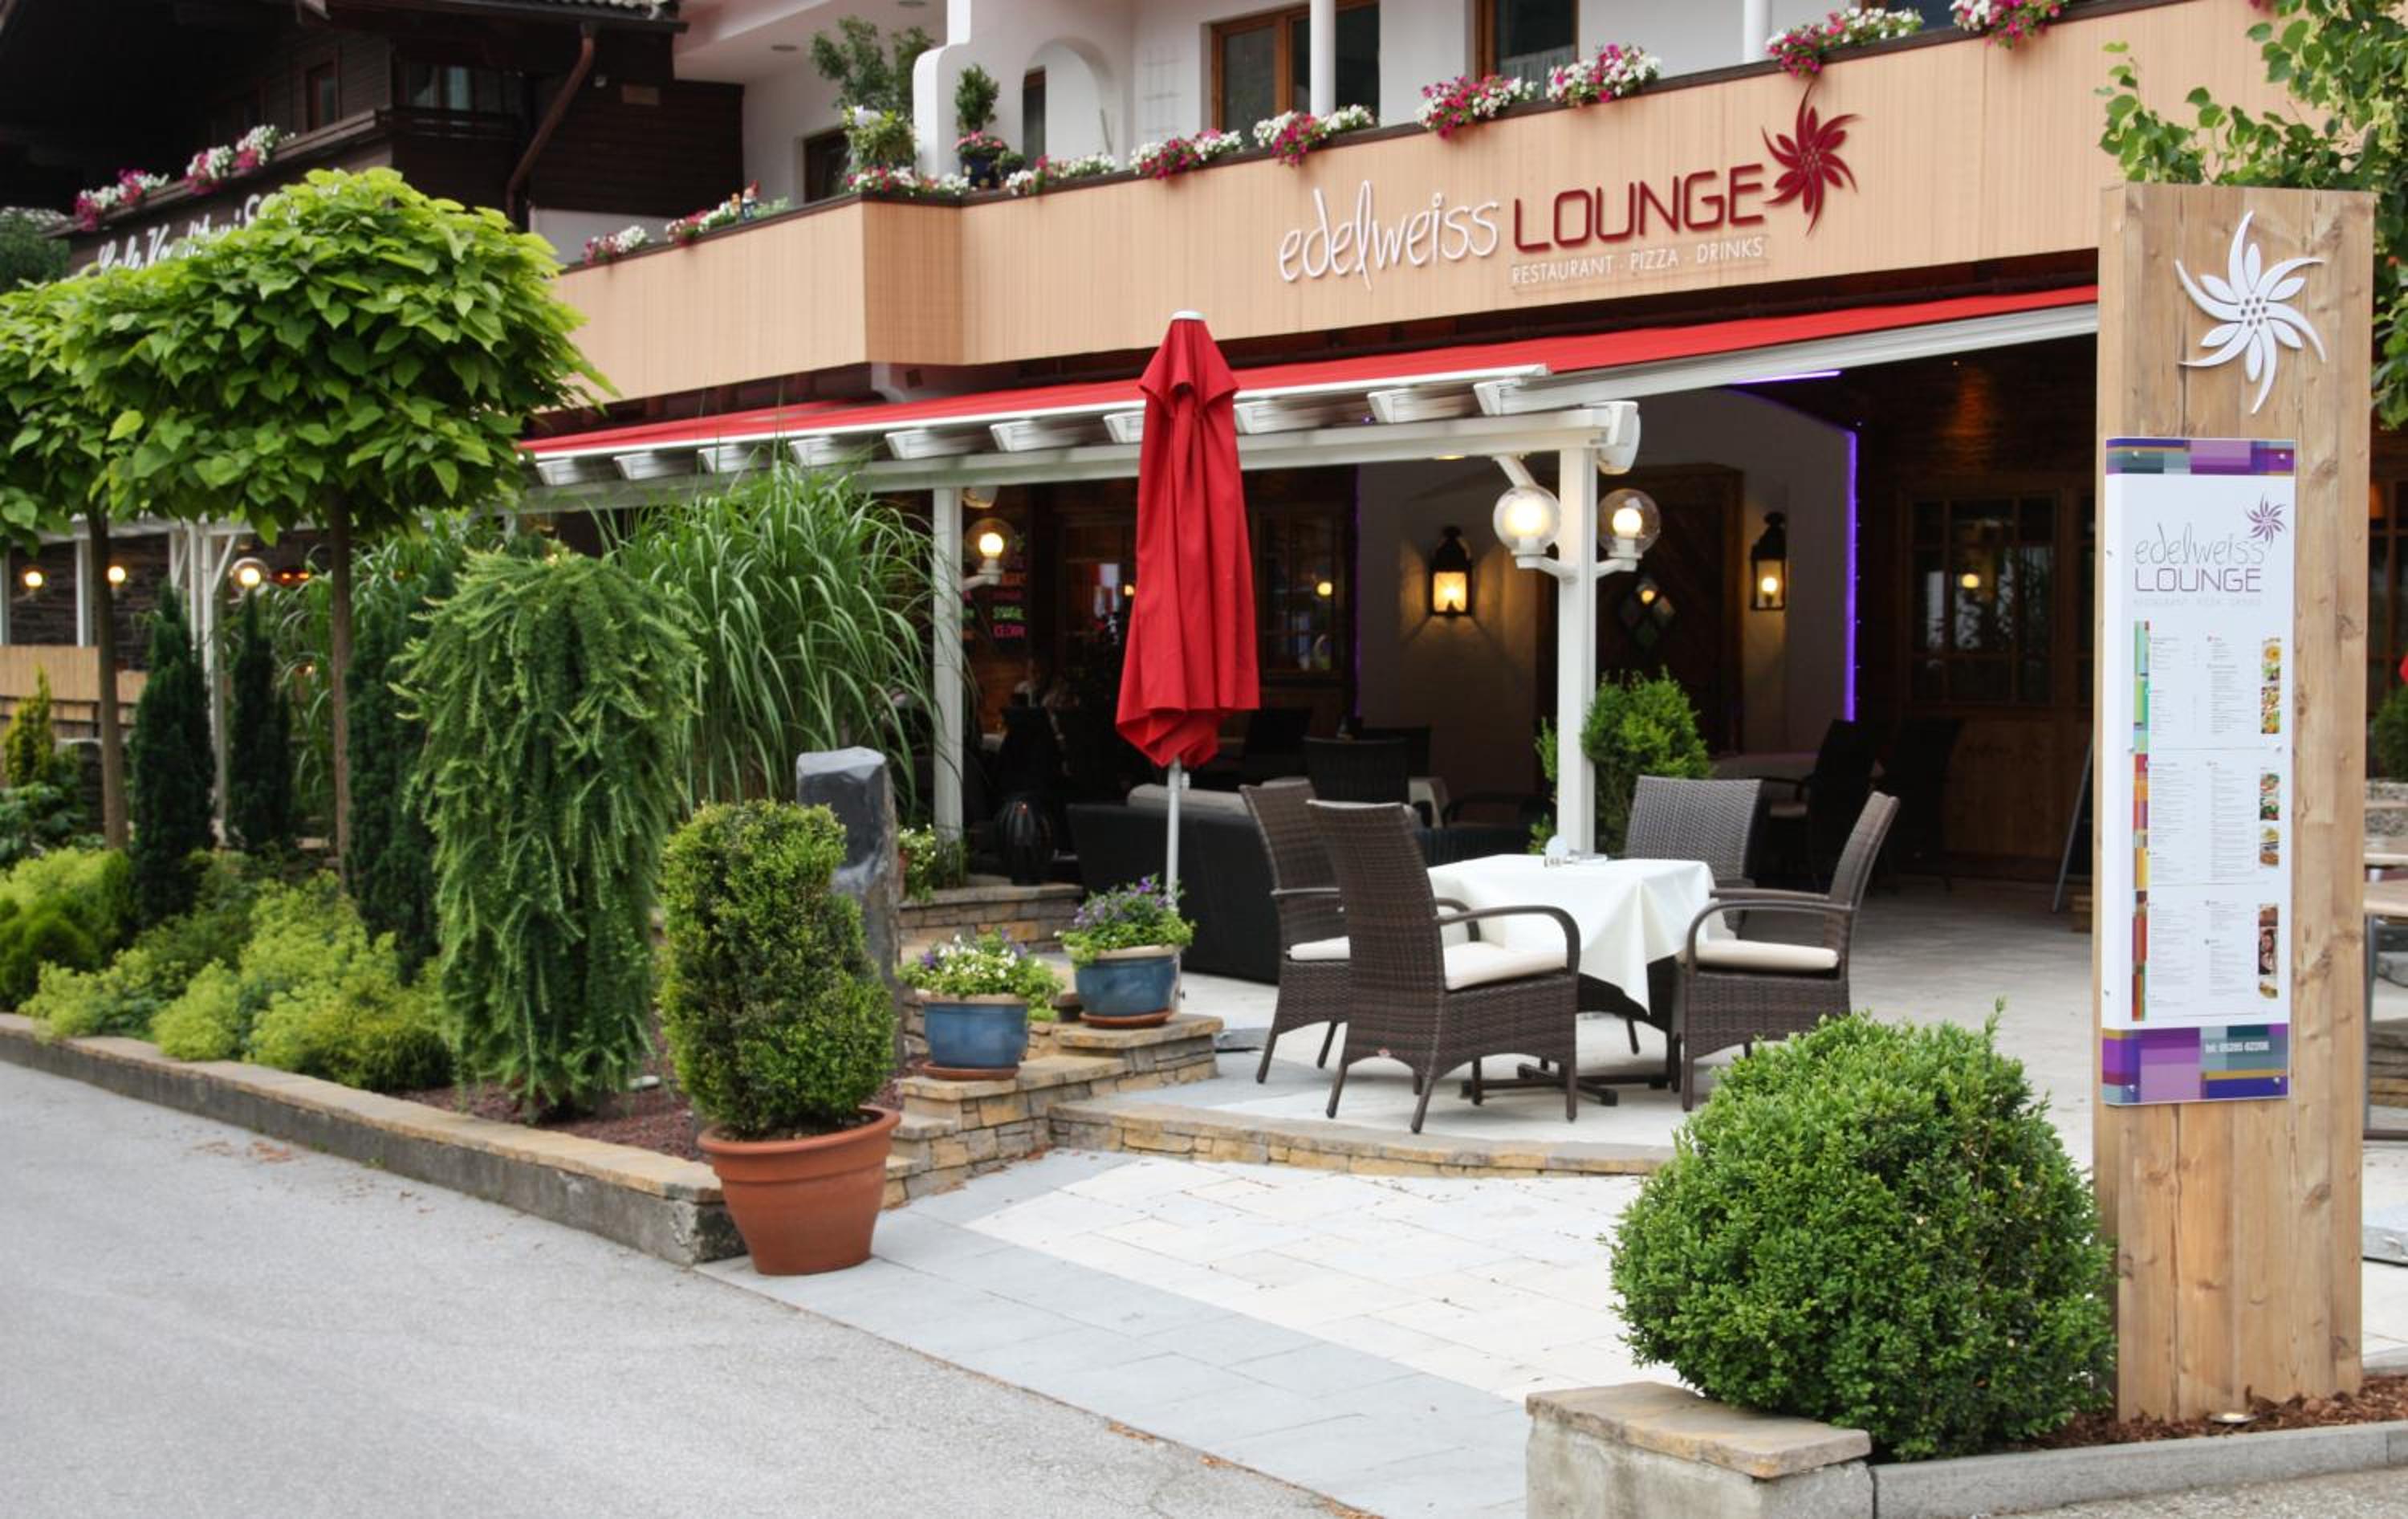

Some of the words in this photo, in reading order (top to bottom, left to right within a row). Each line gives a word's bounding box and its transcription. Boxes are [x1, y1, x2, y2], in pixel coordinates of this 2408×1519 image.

[1279, 179, 1499, 291] edelweiss
[1514, 163, 1764, 253] LOUNGE
[1511, 255, 1614, 284] RESTAURANT
[1630, 248, 1678, 271] PIZZA
[1695, 237, 1763, 264] DRINKS
[2133, 521, 2265, 565] edelweiss
[2134, 568, 2261, 593] LOUNGE
